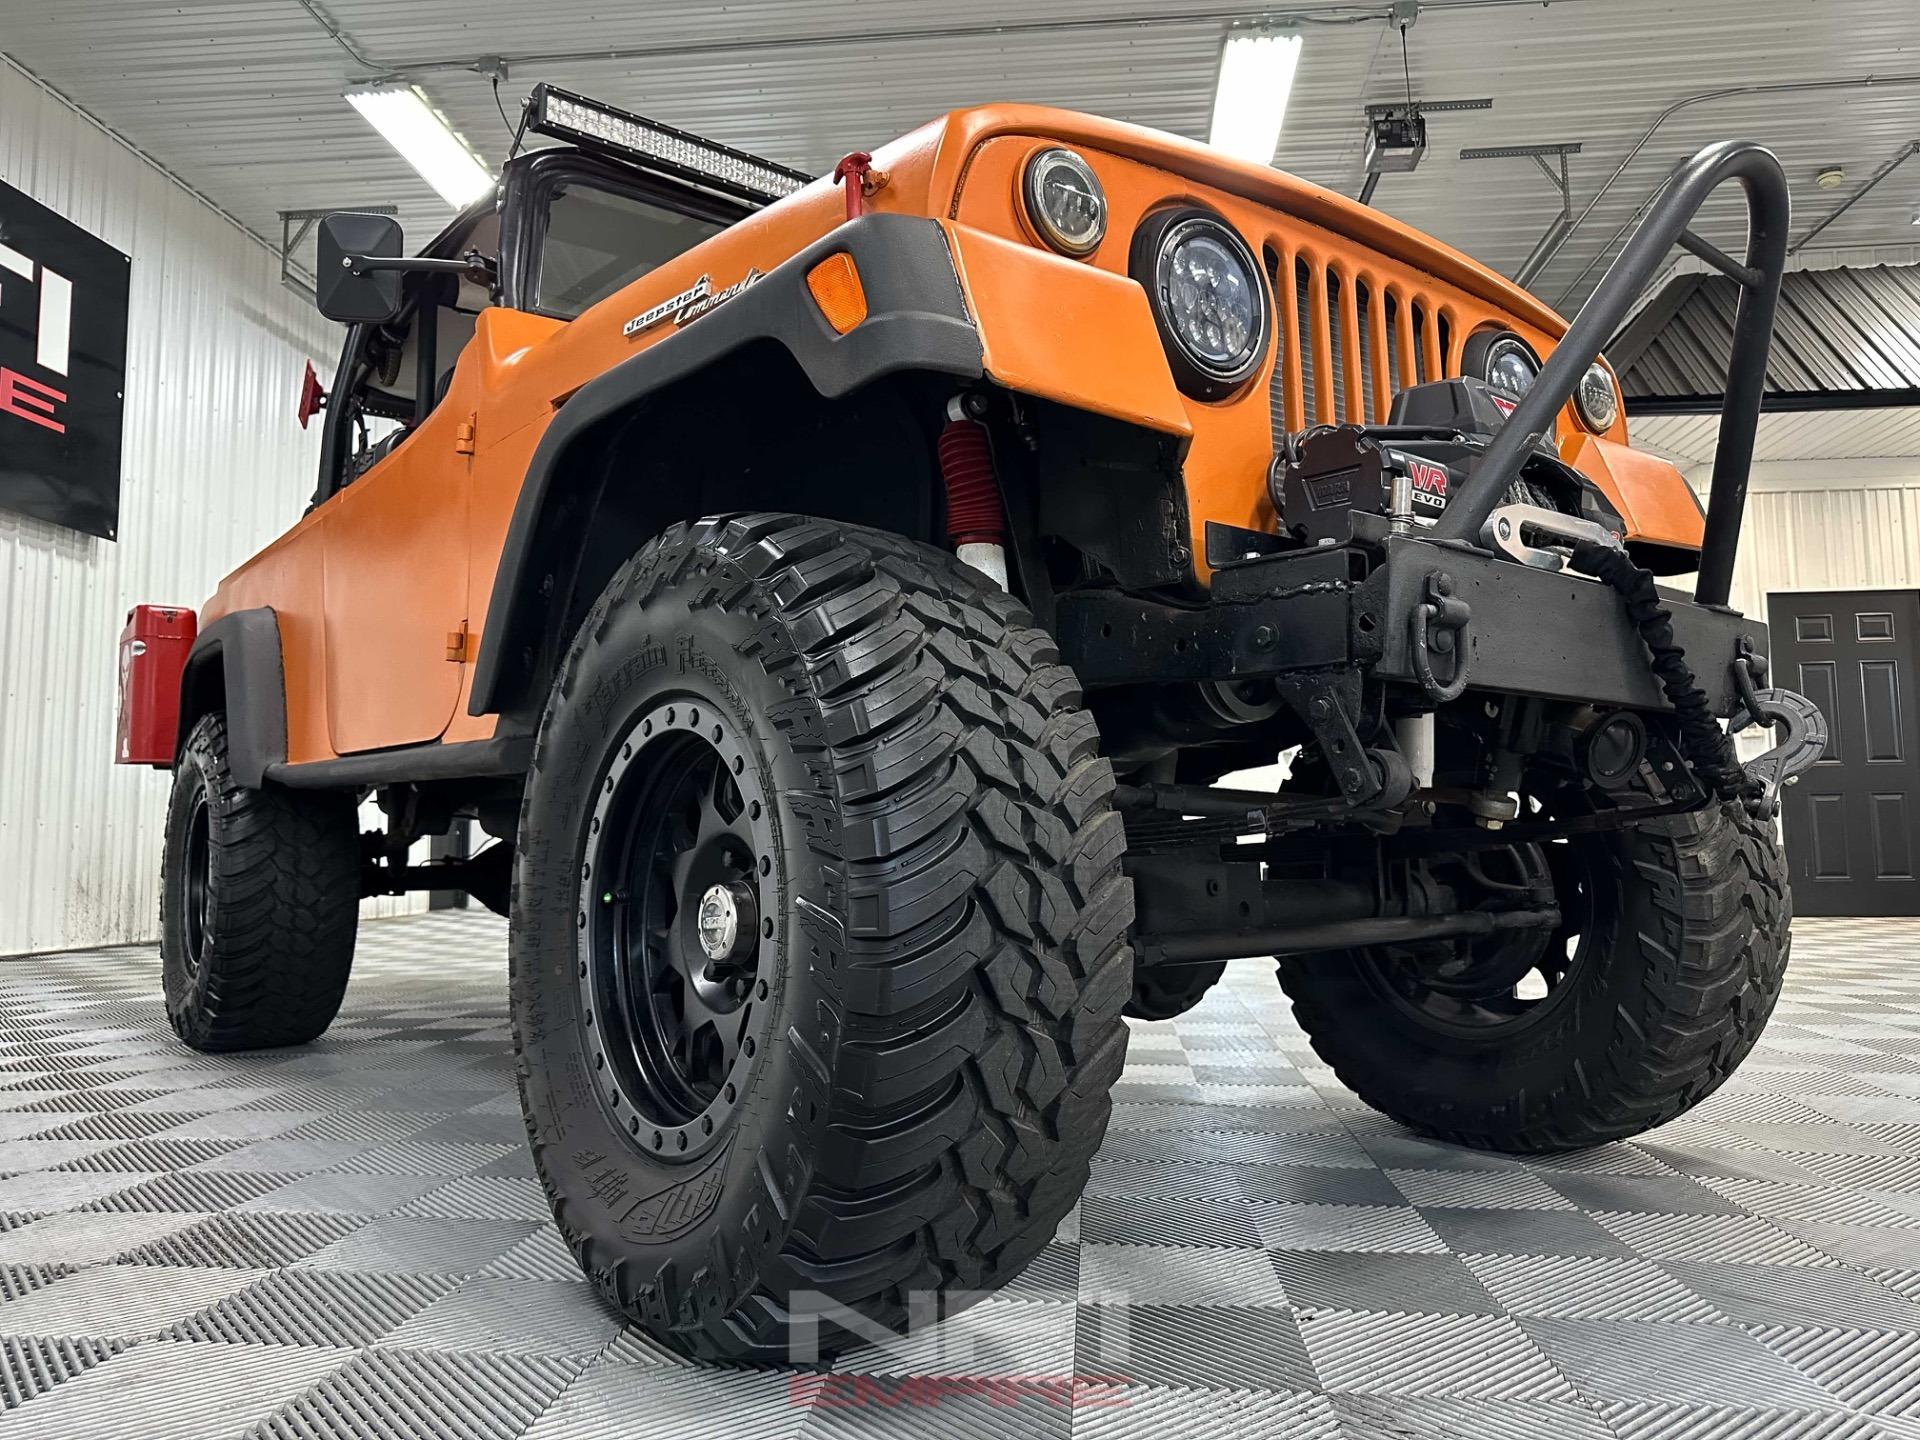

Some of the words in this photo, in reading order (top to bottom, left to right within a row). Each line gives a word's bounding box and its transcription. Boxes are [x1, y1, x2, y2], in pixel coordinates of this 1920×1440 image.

[625, 286, 704, 334] Jeepster
[1408, 461, 1448, 496] VR
[1413, 493, 1444, 508] EVO
